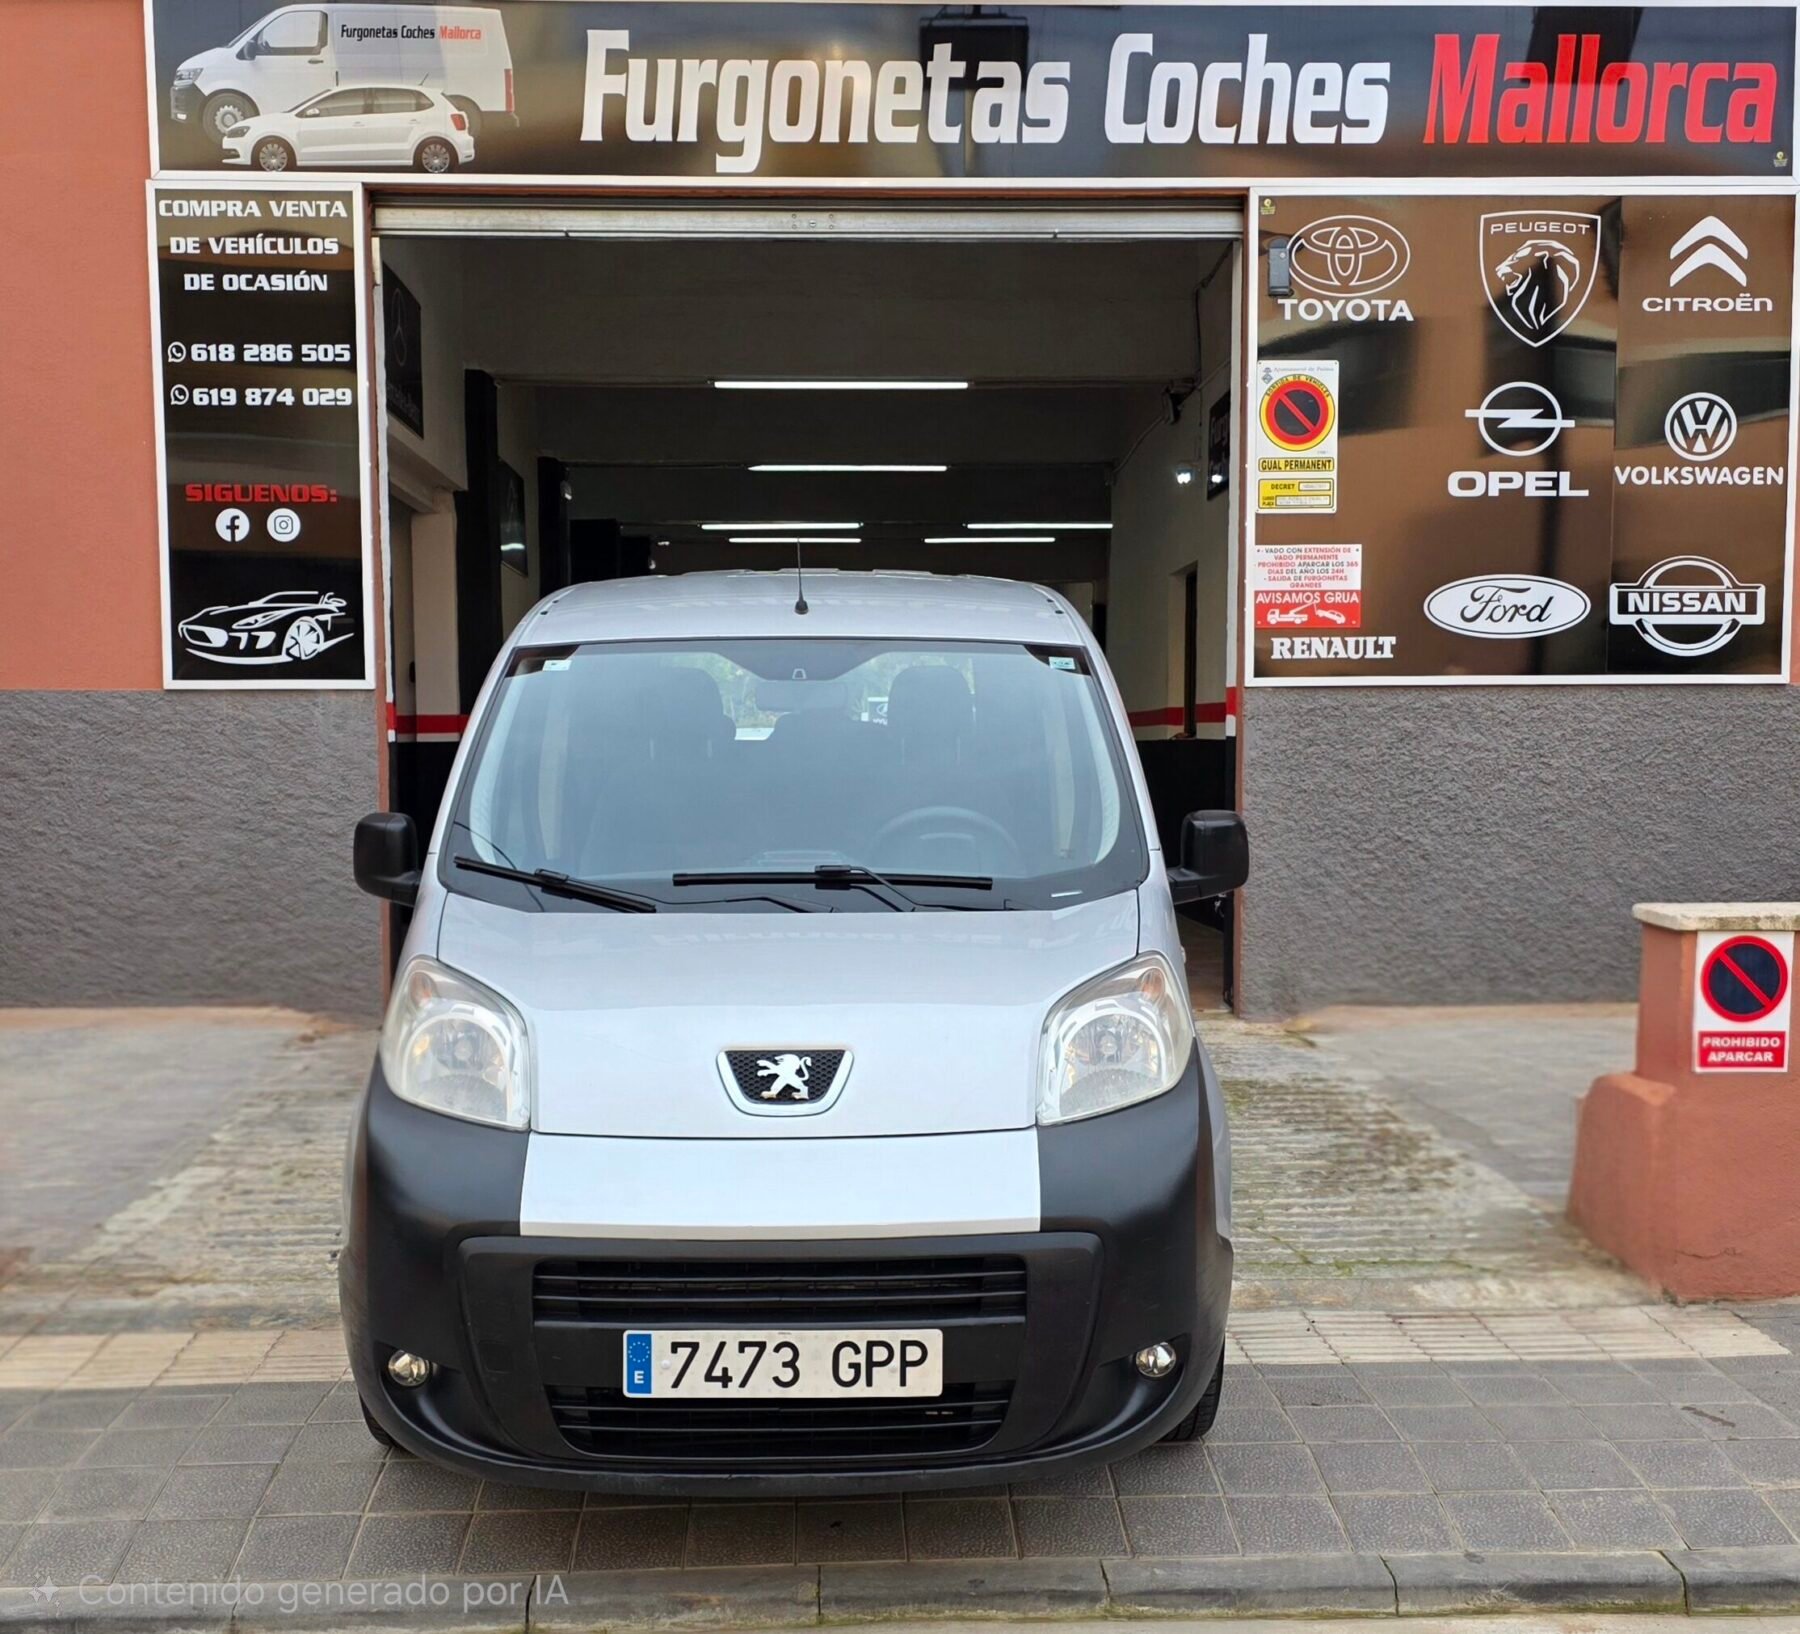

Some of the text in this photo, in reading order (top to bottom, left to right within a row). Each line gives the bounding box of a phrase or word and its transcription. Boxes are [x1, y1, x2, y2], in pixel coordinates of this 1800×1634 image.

[341, 25, 481, 41] Furgonetas Coches Mallorca
[580, 29, 1778, 173] Furgonetas Coches Mallorca
[159, 199, 347, 218] COMPRA VENTA
[1491, 222, 1590, 235] PEUGEOT
[170, 233, 339, 254] DE VEHÍCULOS
[184, 270, 328, 291] DE OCASIÓN
[1277, 299, 1414, 322] TOYOTA
[1642, 293, 1773, 312] CITROËN
[190, 344, 350, 362] 618 286 505
[192, 388, 352, 406] 619 874 029
[1261, 459, 1332, 471] GUAL PERMANENT
[1447, 471, 1590, 497] OPEL
[1614, 465, 1784, 485] VOLKSWAGEN
[185, 483, 338, 503] SIGUENOS:
[1256, 592, 1359, 604] AVISAMOS GRUA
[1460, 584, 1555, 624] Ford
[1627, 592, 1746, 613] NISSAN
[1270, 636, 1397, 659] RENAULT
[1702, 1037, 1780, 1048] PROHIBIDO
[1707, 1051, 1774, 1063] APARCAR
[670, 1339, 928, 1389] 7473 GPP
[634, 1370, 645, 1384] E
